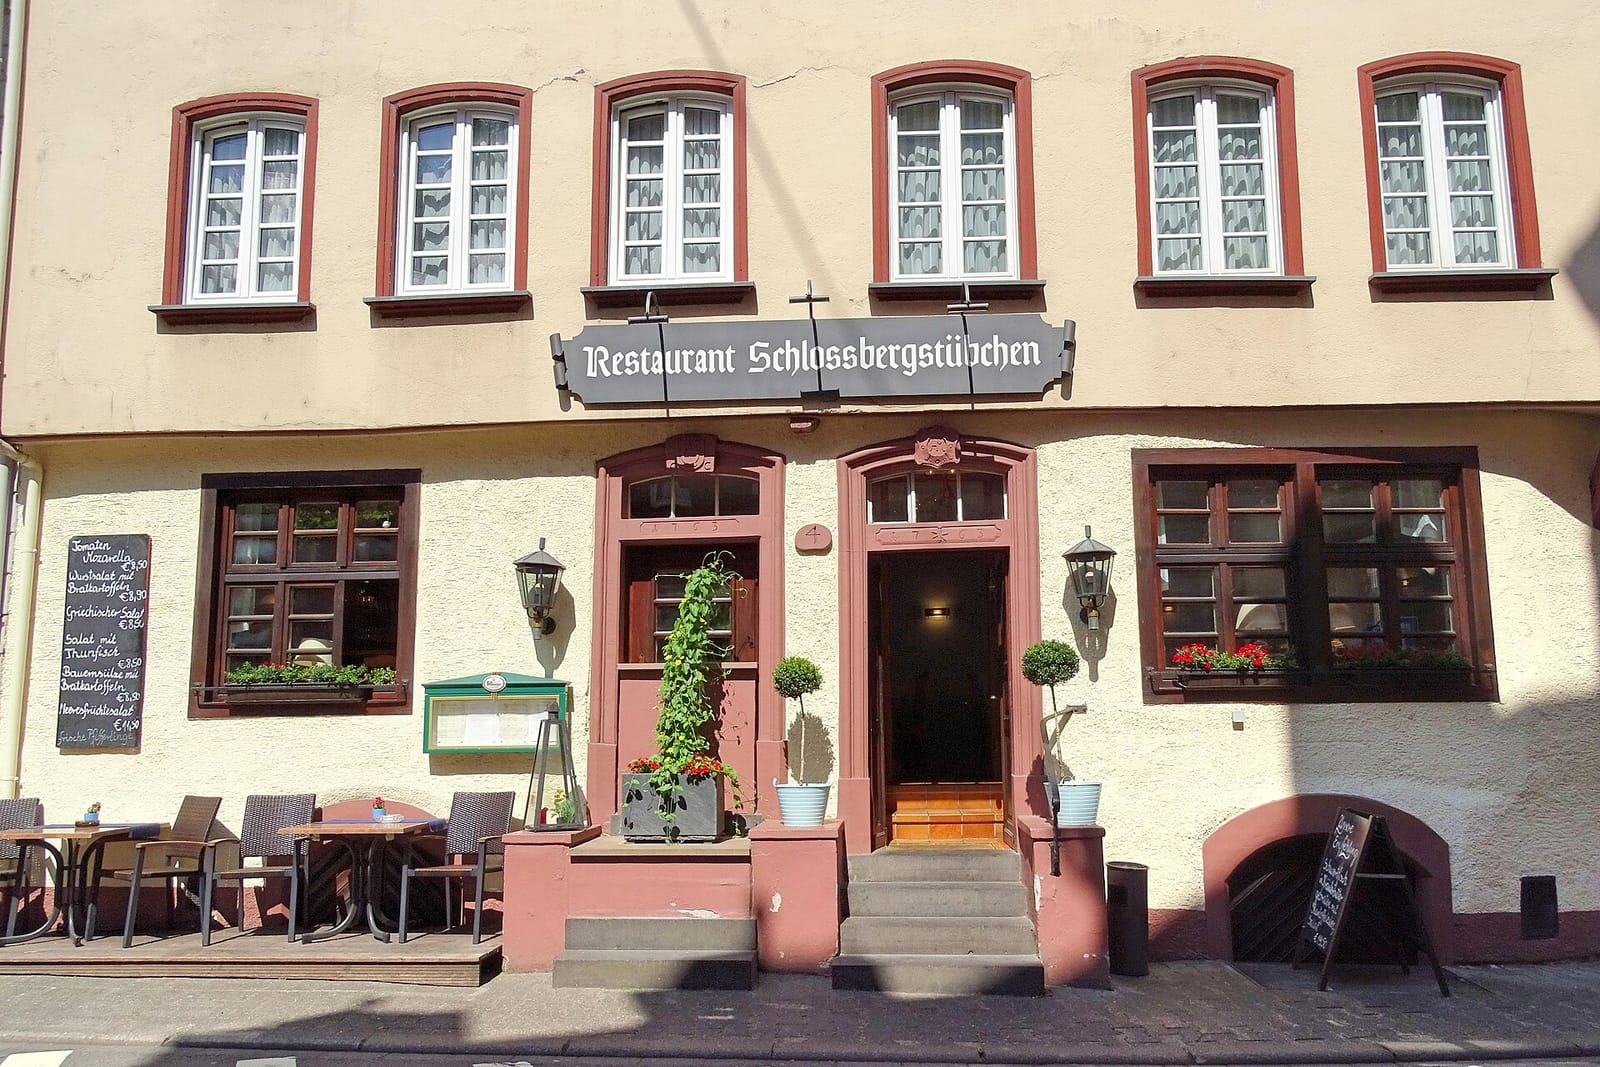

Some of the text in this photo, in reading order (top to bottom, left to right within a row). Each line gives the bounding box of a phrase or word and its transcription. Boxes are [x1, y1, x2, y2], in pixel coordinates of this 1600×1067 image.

[583, 334, 1043, 378] Restaurant Schlossbergstübchen
[804, 525, 821, 545] 4
[71, 539, 112, 552] Tomaten
[82, 549, 134, 564] Mozarella
[68, 568, 136, 581] Wurstsalat mit
[66, 580, 130, 598] Bratkartoffeln
[66, 604, 145, 622] Griechischer Salat
[64, 632, 117, 645] Salat mit
[63, 645, 121, 662] Thunfisch
[61, 664, 139, 679] Bauernsülze mit
[60, 677, 127, 696] Bratkartoffeln
[58, 702, 136, 720] Meeresfrüchtesalat
